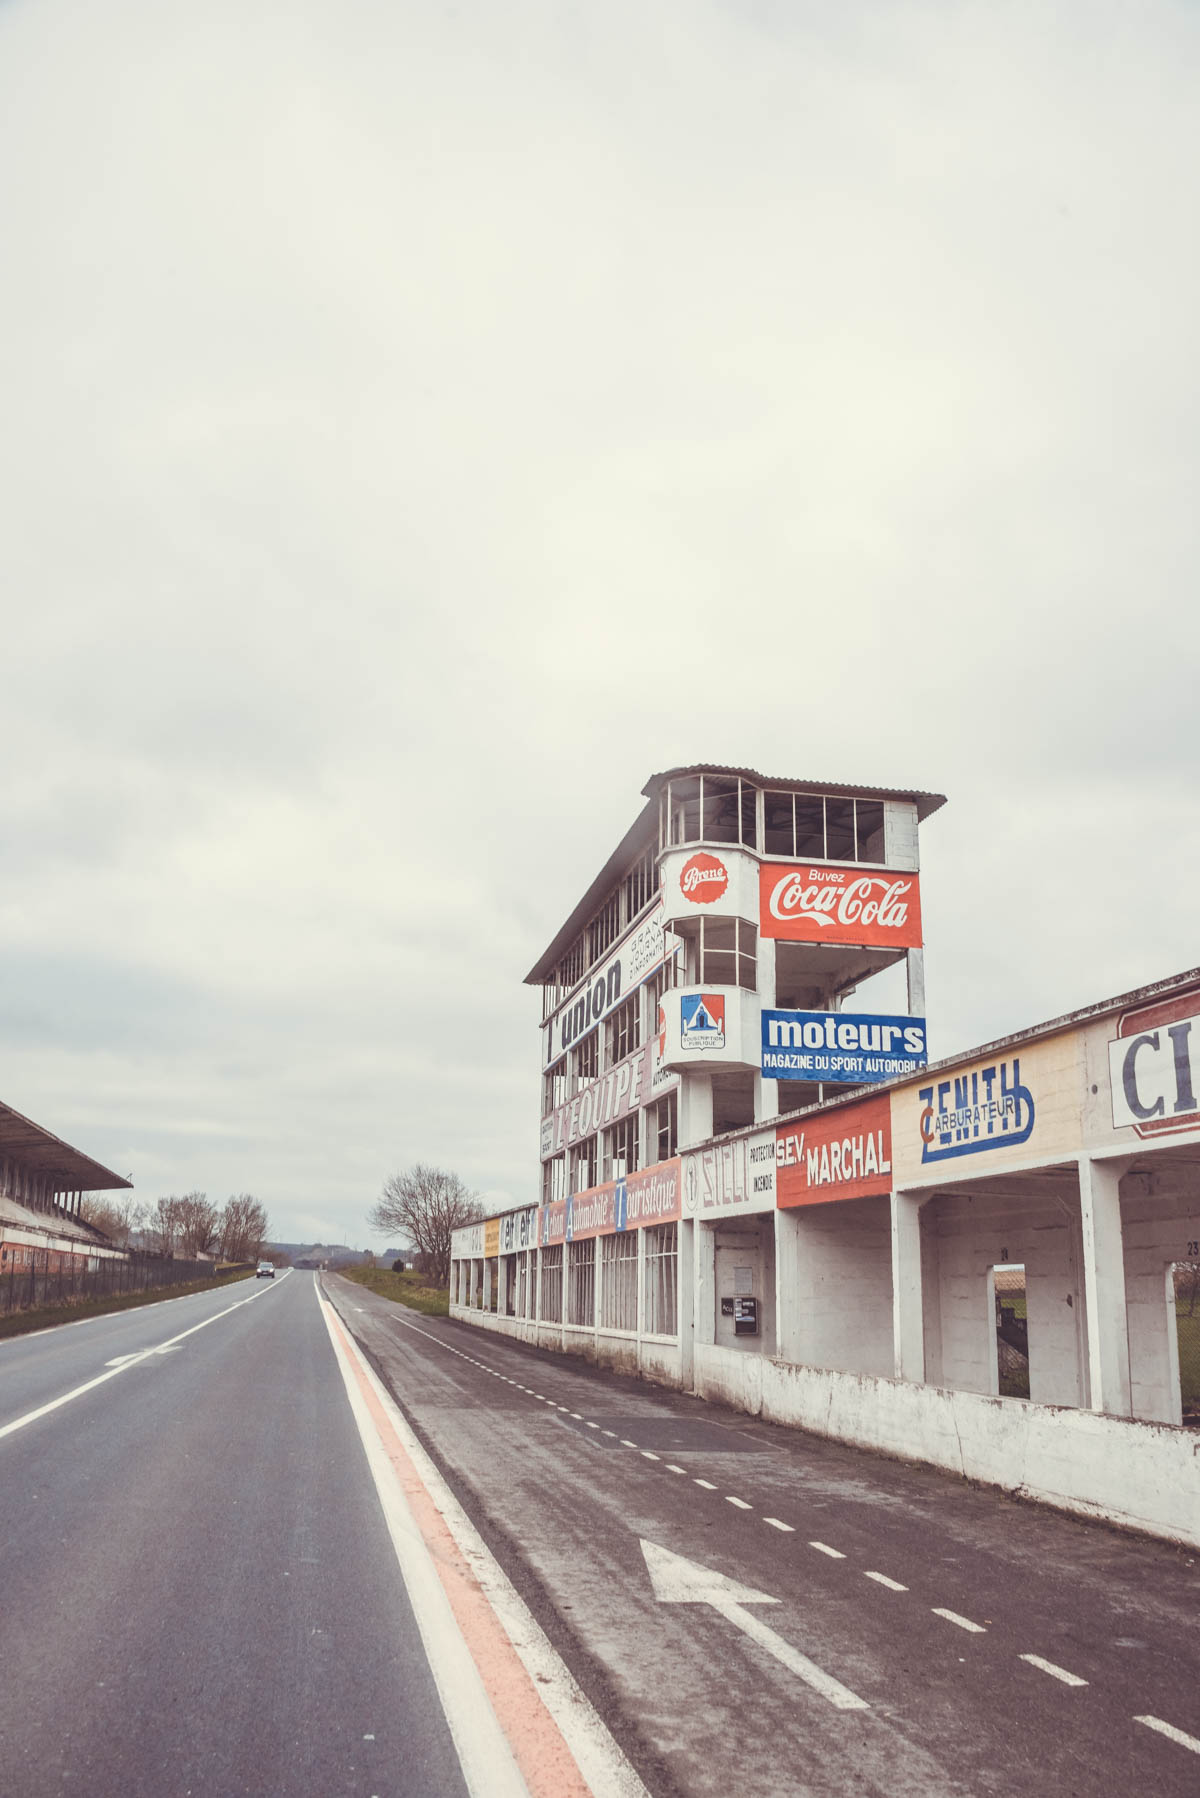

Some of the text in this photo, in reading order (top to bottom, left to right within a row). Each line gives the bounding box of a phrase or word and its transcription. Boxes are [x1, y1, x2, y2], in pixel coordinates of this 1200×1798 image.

[808, 870, 845, 882] Buvez
[769, 872, 912, 928] Coca-Cola
[768, 1017, 924, 1054] moteurs
[763, 1054, 814, 1070] MAGAZINE
[815, 1056, 829, 1071] DU
[830, 1056, 863, 1072] SPORT
[554, 1050, 645, 1151] L'EQUIPE
[750, 1142, 775, 1163] PROTECTION
[807, 1129, 892, 1188] MARCHAL
[753, 1174, 773, 1193] INCENDIE
